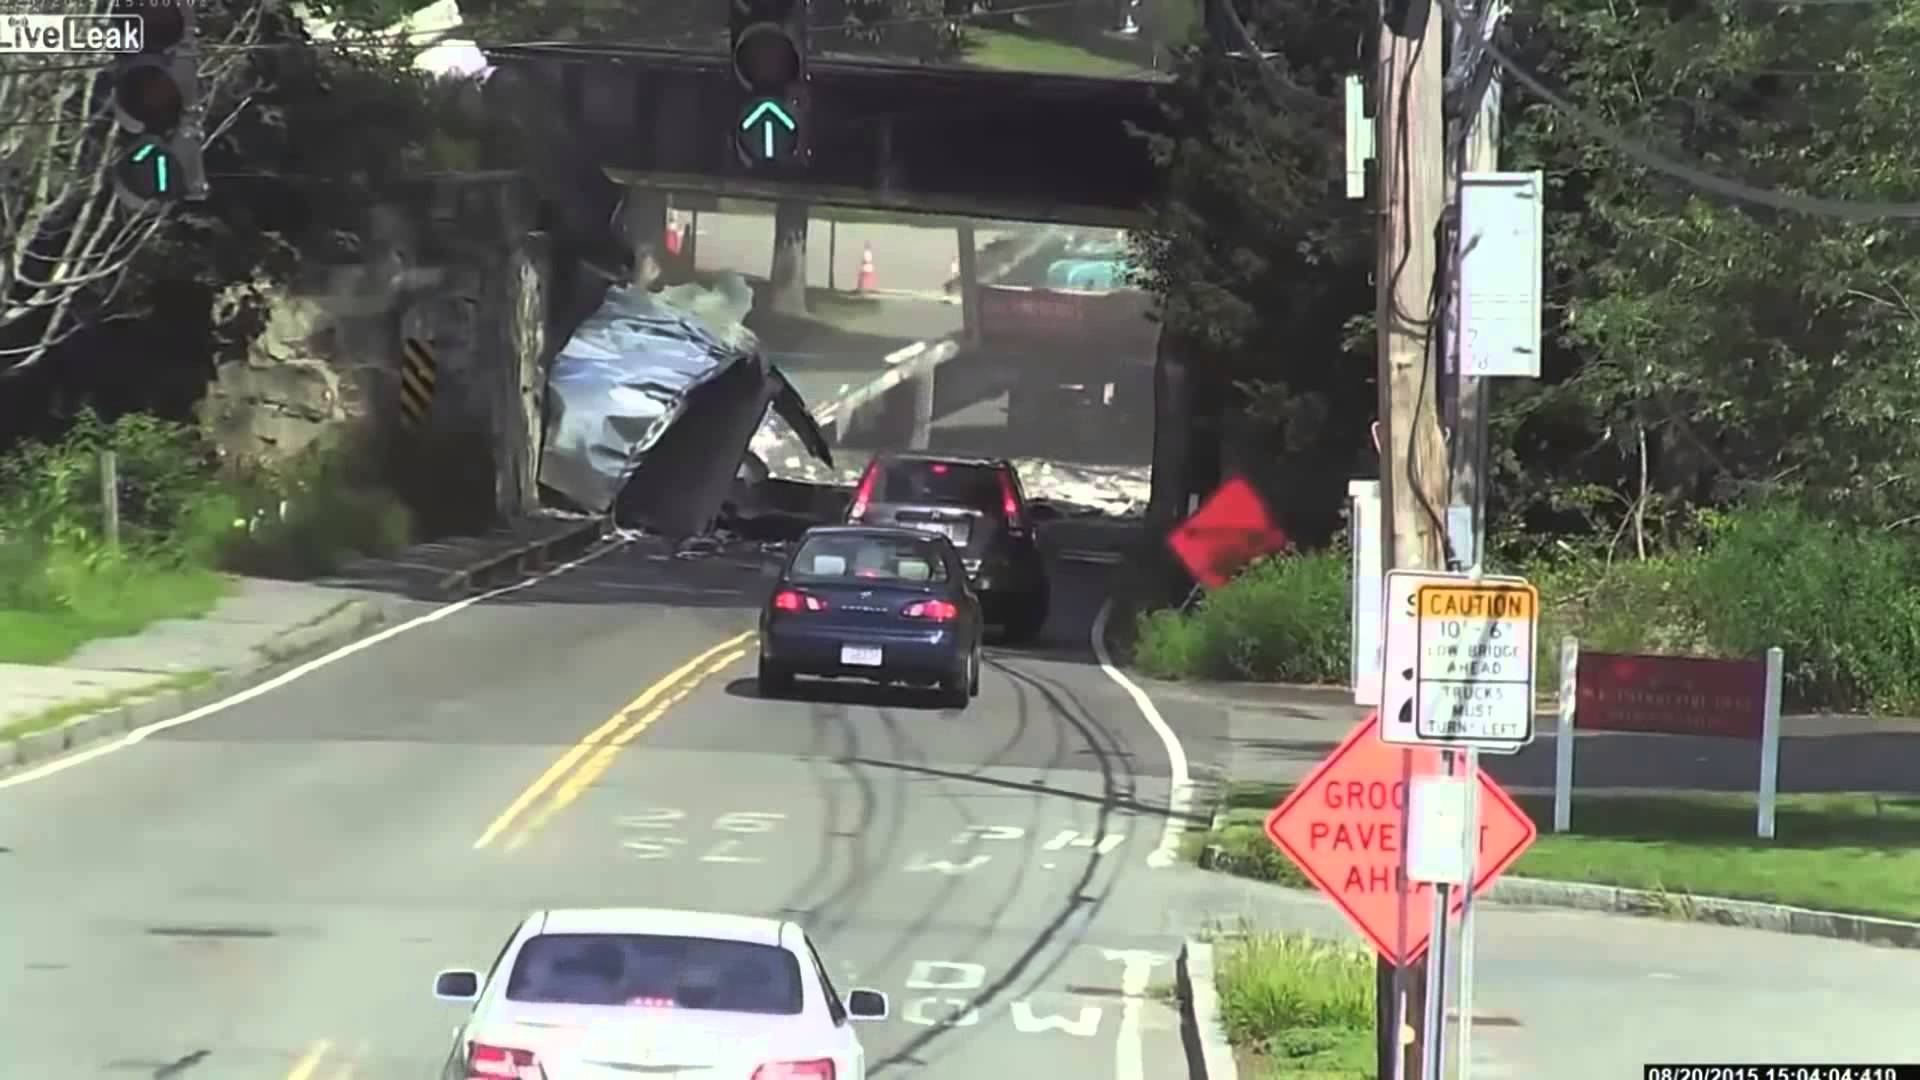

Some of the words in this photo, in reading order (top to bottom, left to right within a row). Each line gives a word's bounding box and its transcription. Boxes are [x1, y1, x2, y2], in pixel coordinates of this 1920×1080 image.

[1430, 593, 1522, 618] CAUTION
[1428, 645, 1458, 657] LOW
[1468, 644, 1519, 658] BRIDGE
[1447, 661, 1502, 676] AHEAD
[1441, 686, 1503, 700] TRUCKS
[1452, 704, 1493, 717] MUST
[1428, 720, 1467, 733] TURN
[1482, 723, 1518, 736] LEFT
[1310, 823, 1488, 853] PAVET
